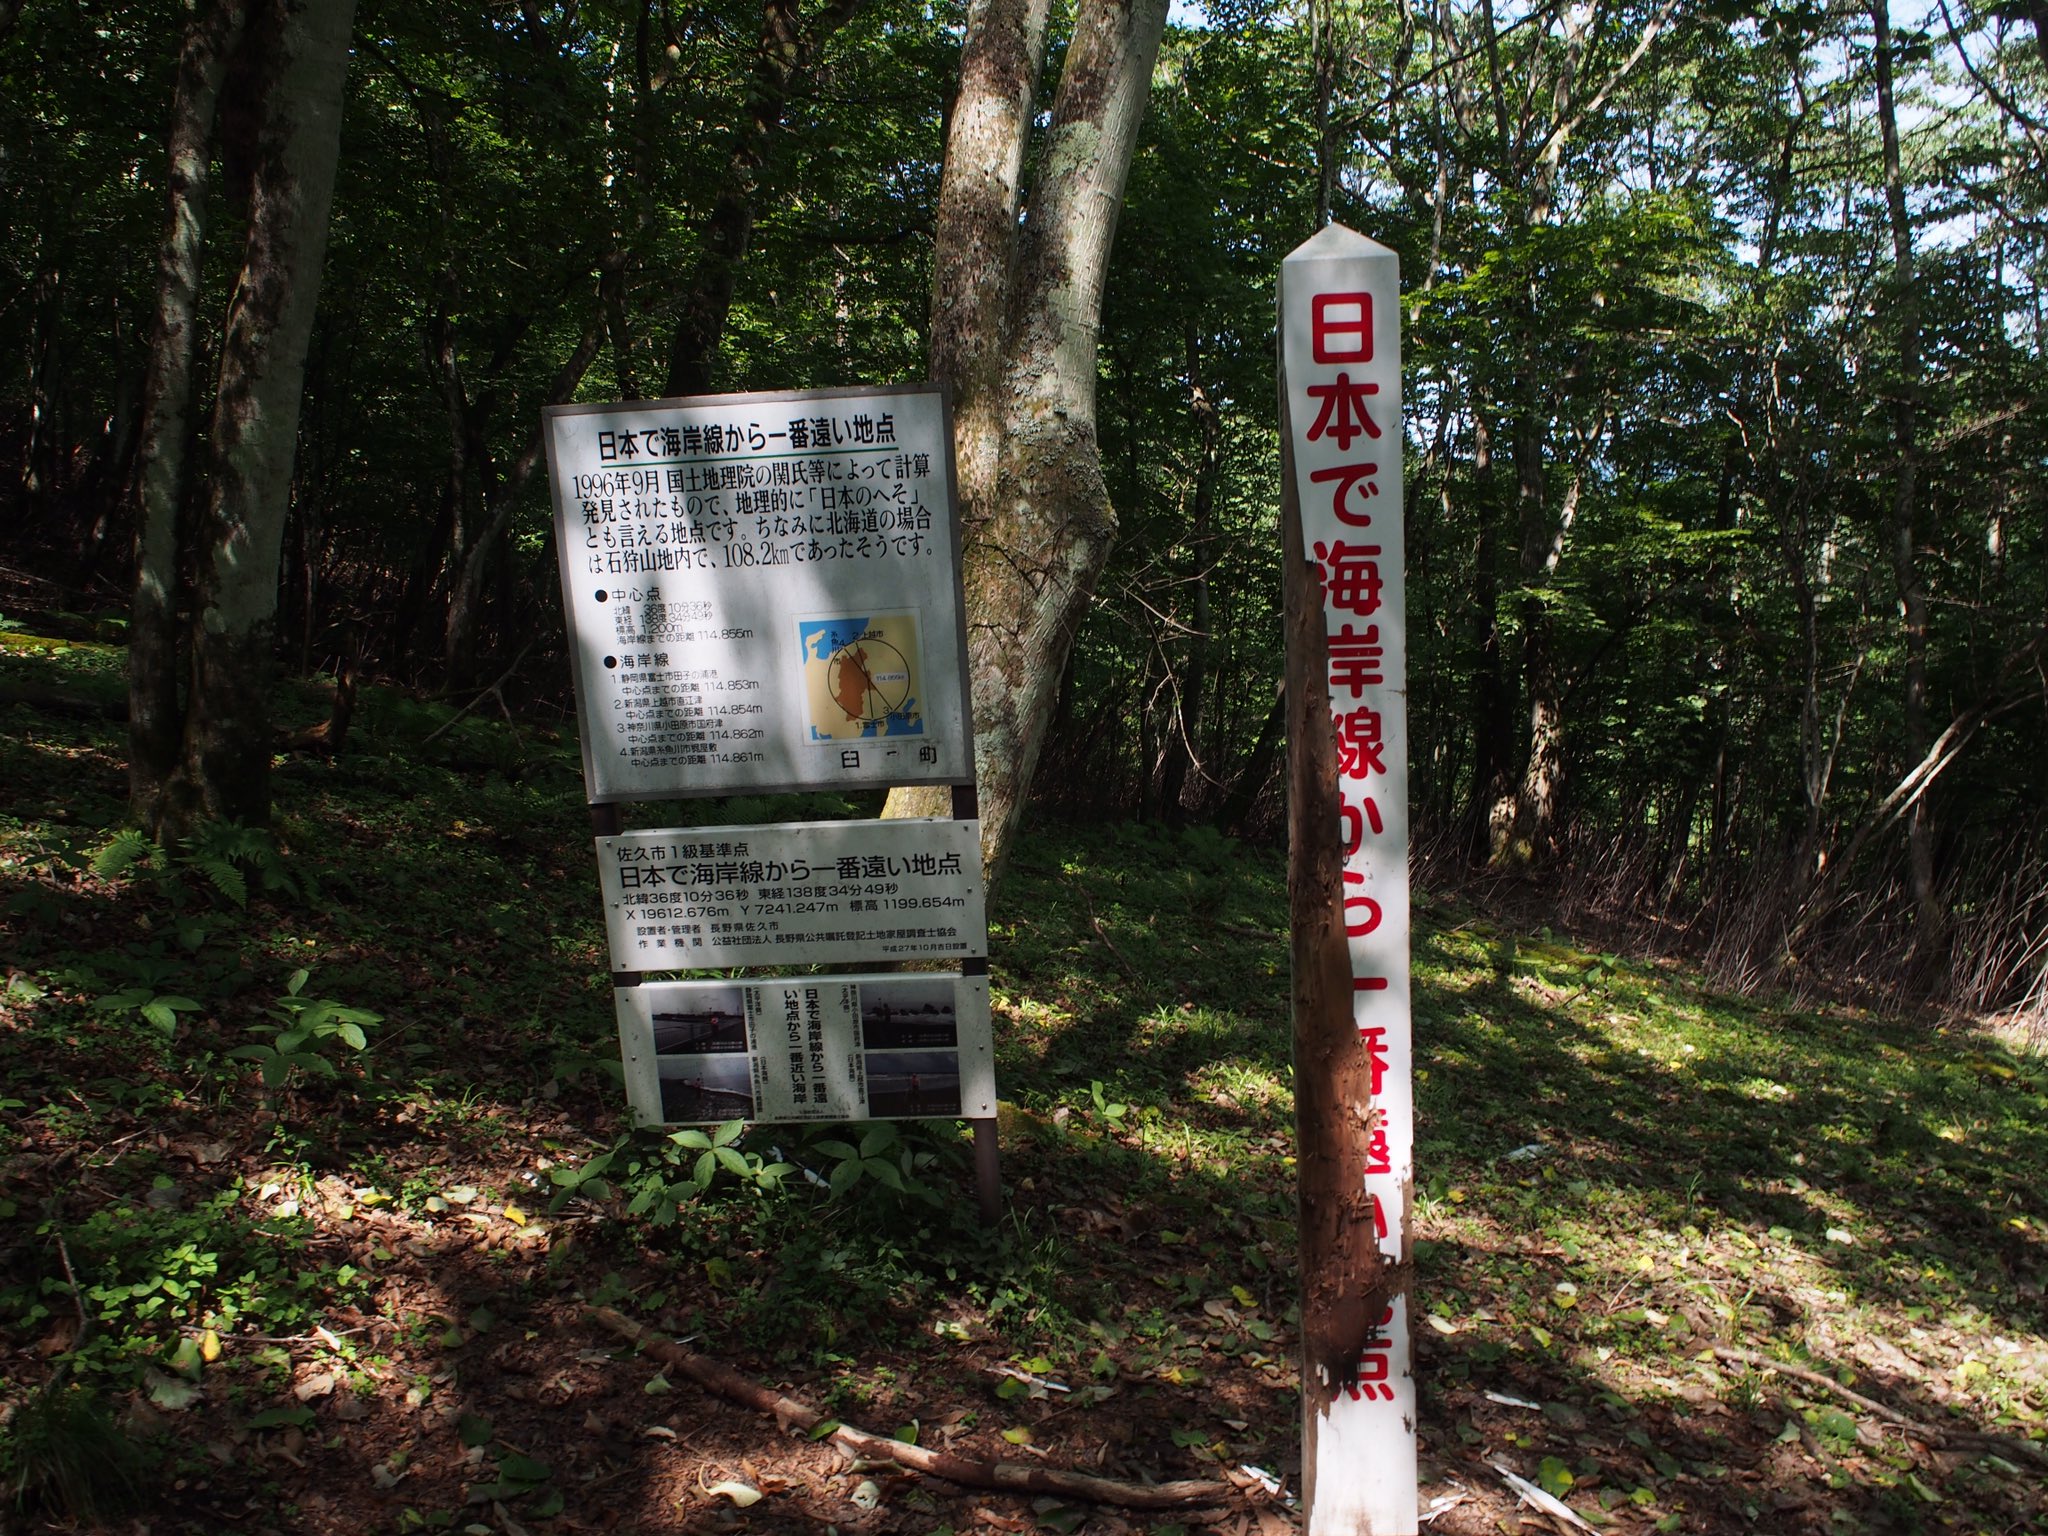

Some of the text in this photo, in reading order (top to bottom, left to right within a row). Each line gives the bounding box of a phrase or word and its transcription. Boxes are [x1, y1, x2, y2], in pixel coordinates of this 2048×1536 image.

[598, 413, 897, 461] 日本で海岸線から一番遠い地点
[573, 470, 660, 499] 1996年9月
[582, 483, 919, 524] 発見されたもので、地理的に「日本のへそ」
[586, 505, 932, 549] とも言える地点です。ちなみに北海道の場合
[611, 586, 662, 602] 中心点
[617, 628, 754, 646] 海岸線までの距離 114.855m
[619, 652, 670, 669] 海岸線
[622, 679, 760, 696] 中心点までの距離 114.853m
[626, 704, 763, 720] 中心点までの距離 114.854m
[628, 728, 764, 744] 中心点までの距離 114.862m
[631, 751, 764, 768] 中心点までの距離 114.861m
[619, 852, 963, 889] 日本で海岸線から一番遠い地点
[623, 883, 898, 907] 北緯36度10分36秒 東経138度34分49秒
[626, 896, 966, 921] X 19612.676m Y 7241.247m 標高 1199.654m
[710, 921, 779, 935] 長野県佐久市
[712, 934, 773, 948] 公益社団法人
[805, 988, 828, 1104] 日本で海岸線から一番遠
